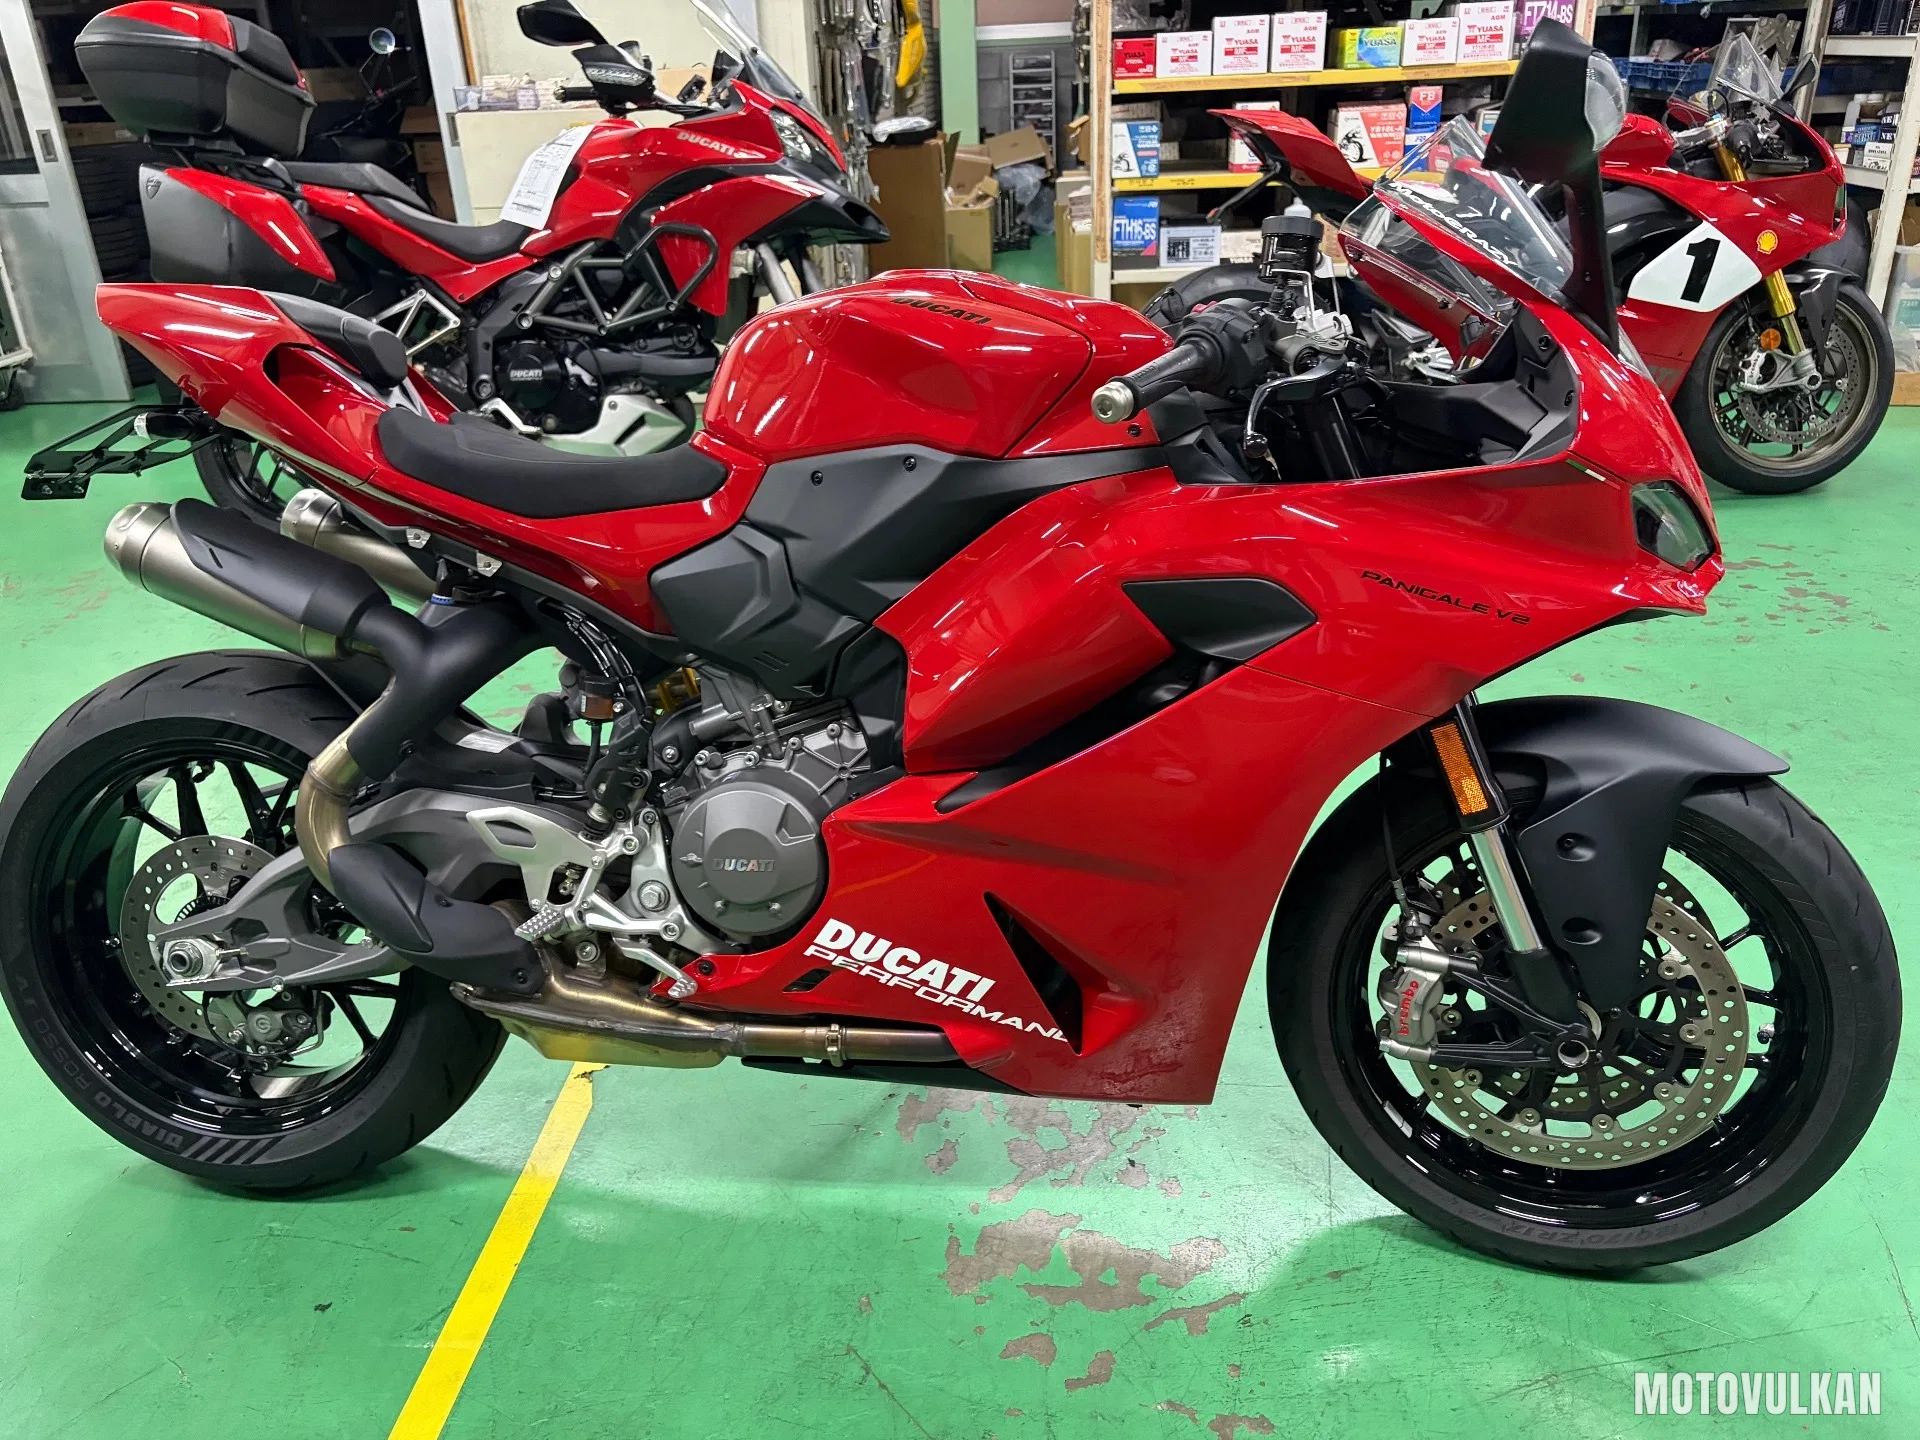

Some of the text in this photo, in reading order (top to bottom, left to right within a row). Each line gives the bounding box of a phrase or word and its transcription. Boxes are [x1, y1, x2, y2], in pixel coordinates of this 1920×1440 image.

[1477, 25, 1504, 33] YUASA
[1363, 38, 1397, 47] YUASA
[1419, 91, 1436, 101] FB
[676, 131, 735, 156] DUCATI
[1680, 237, 1721, 303] 1
[889, 297, 992, 325] DUCATI
[510, 369, 543, 377] DUCATI
[1496, 608, 1531, 626] V2
[712, 858, 775, 872] DUCATI
[813, 918, 996, 1002] DUCATI
[1397, 980, 1419, 1036] brembo
[35, 1018, 92, 1090] ROSSO
[94, 1091, 184, 1148] DIABLO
